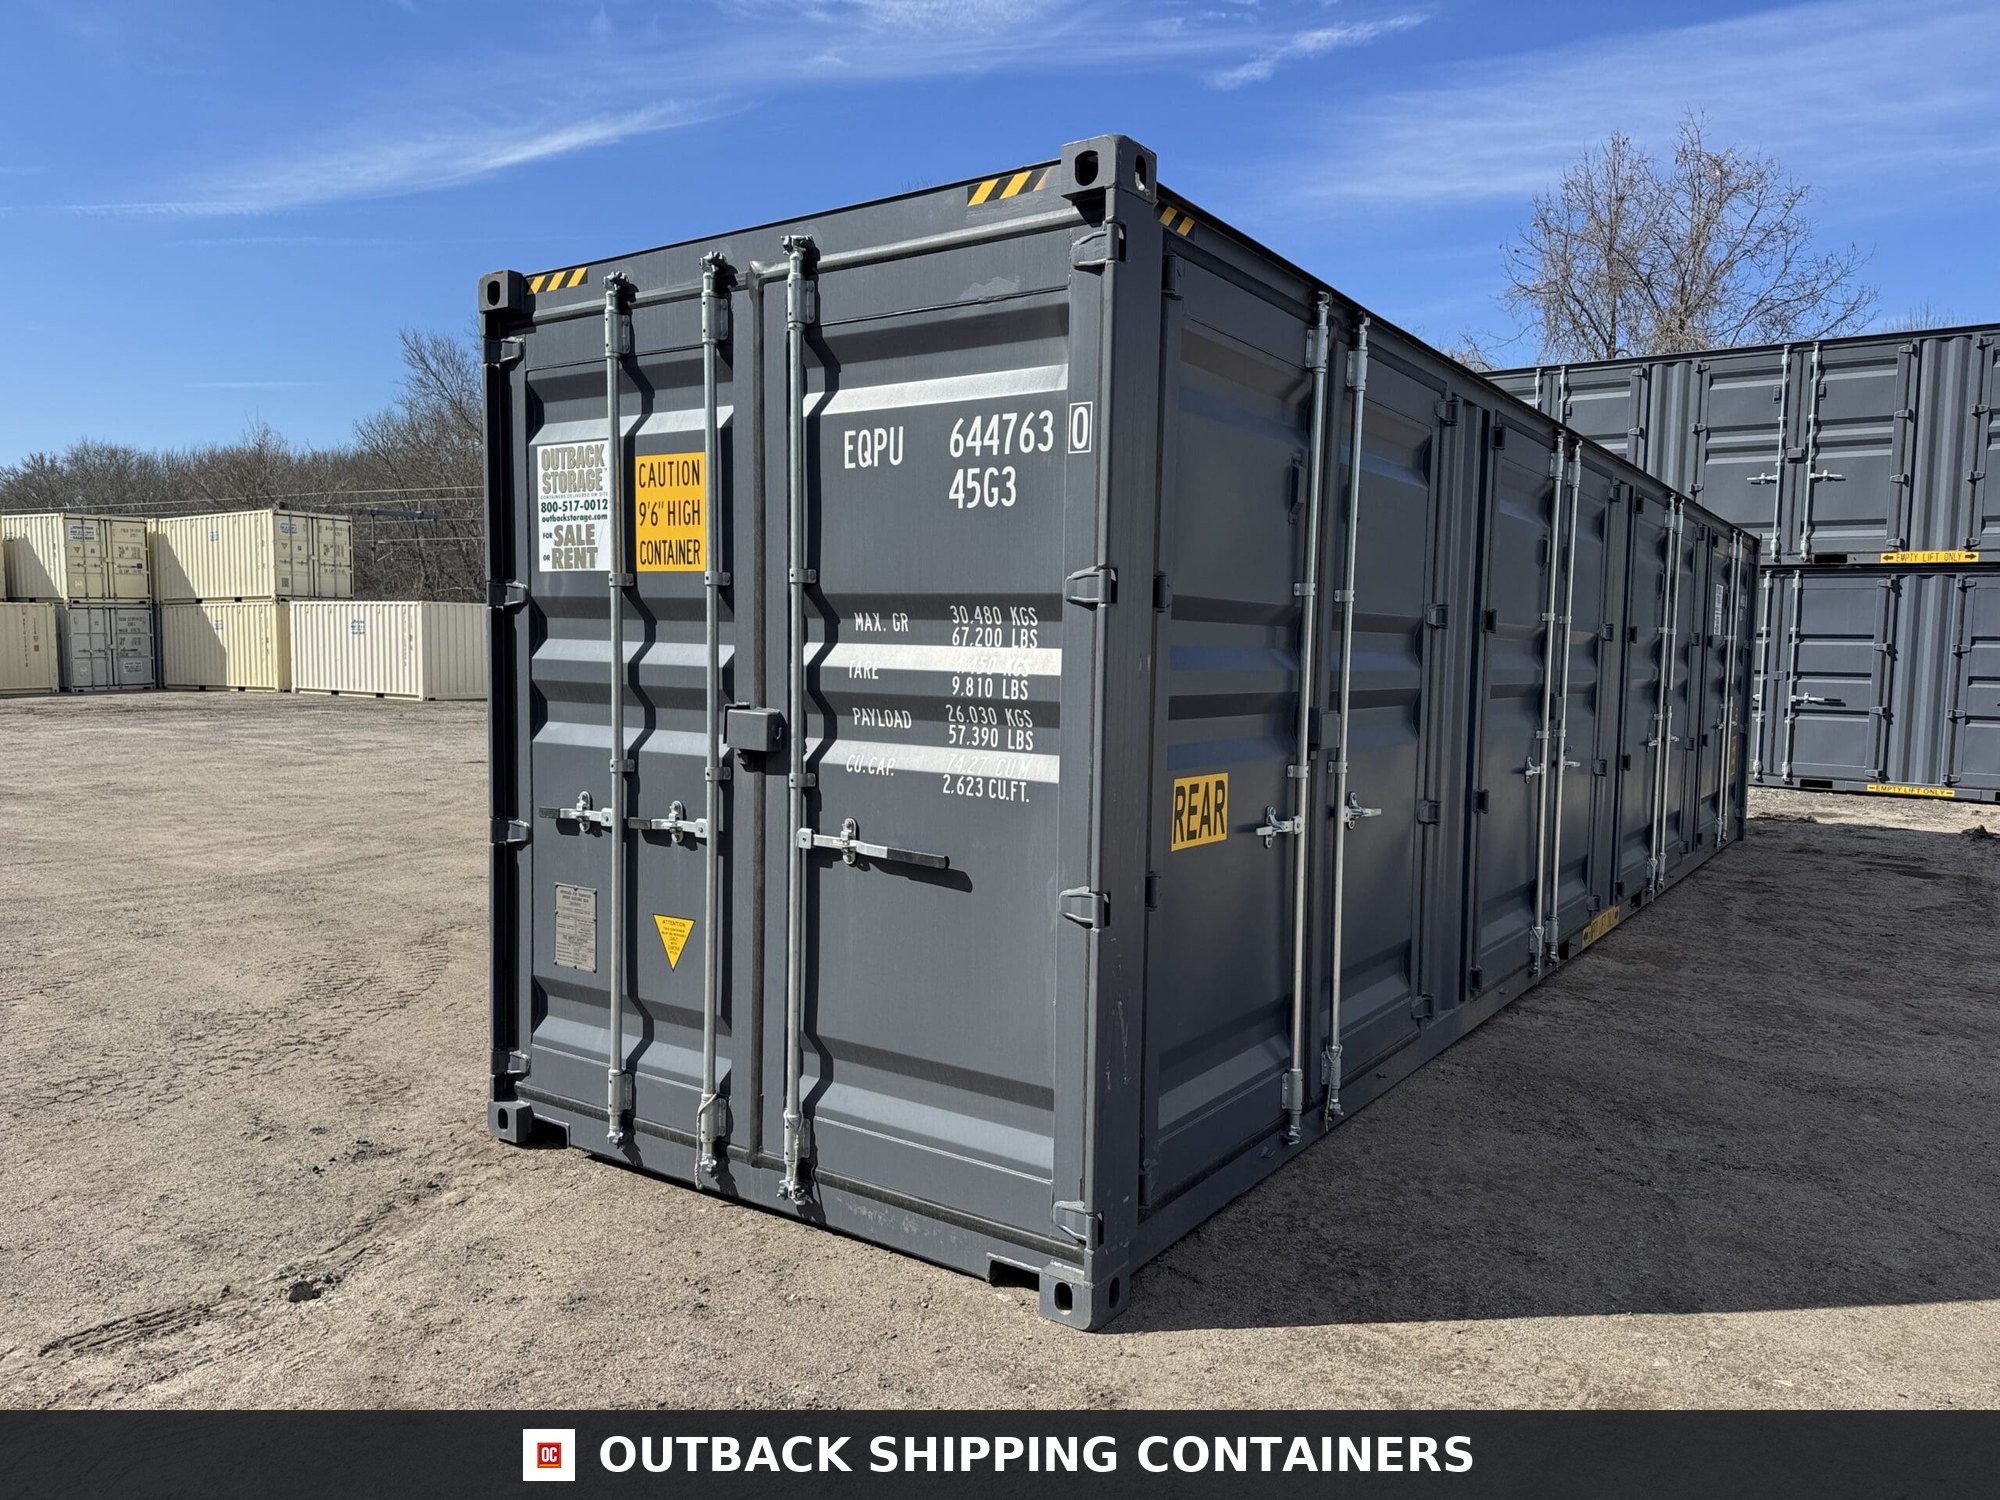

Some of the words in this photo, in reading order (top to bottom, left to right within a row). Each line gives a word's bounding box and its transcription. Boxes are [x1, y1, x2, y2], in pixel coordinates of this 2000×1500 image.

[844, 426, 903, 468] EQPU
[949, 409, 1053, 457] 644763
[1071, 405, 1089, 450] 0
[541, 444, 605, 471] OUTBACK
[542, 468, 603, 494] STORAGE
[639, 459, 700, 488] CAUTION
[949, 465, 1016, 509] 45G3
[541, 499, 608, 513] 800-517-0012
[542, 513, 608, 522] outbackstorage.com
[639, 501, 664, 527] 9'6"
[667, 499, 700, 526] HIGH
[554, 523, 596, 547] SALE
[552, 546, 598, 569] RENT
[640, 539, 700, 565] CONTAINER
[1896, 553, 1917, 563] EMPTY
[1922, 552, 1940, 562] LIFT
[1944, 552, 1963, 562] ONLY
[854, 612, 887, 632] MAX.
[892, 612, 909, 632] GR
[1009, 606, 1038, 626] KGS
[952, 626, 1002, 648] 67,200
[1011, 627, 1038, 649] LBS
[849, 660, 880, 680] TARE
[952, 675, 993, 698] 9,810
[1002, 678, 1029, 700] LBS
[852, 707, 912, 729] PAYLOAD
[1004, 707, 1033, 728] KGS
[948, 724, 999, 748] 57,390
[1007, 728, 1034, 751] LBS
[846, 754, 896, 776] CU.CAP.
[946, 753, 989, 775] 74.27
[942, 773, 984, 798] 2,623
[988, 778, 1030, 803] CU.FT.
[1876, 785, 1902, 793] EMPTY
[1923, 788, 1946, 796] ONLY
[1173, 780, 1225, 845] REAR
